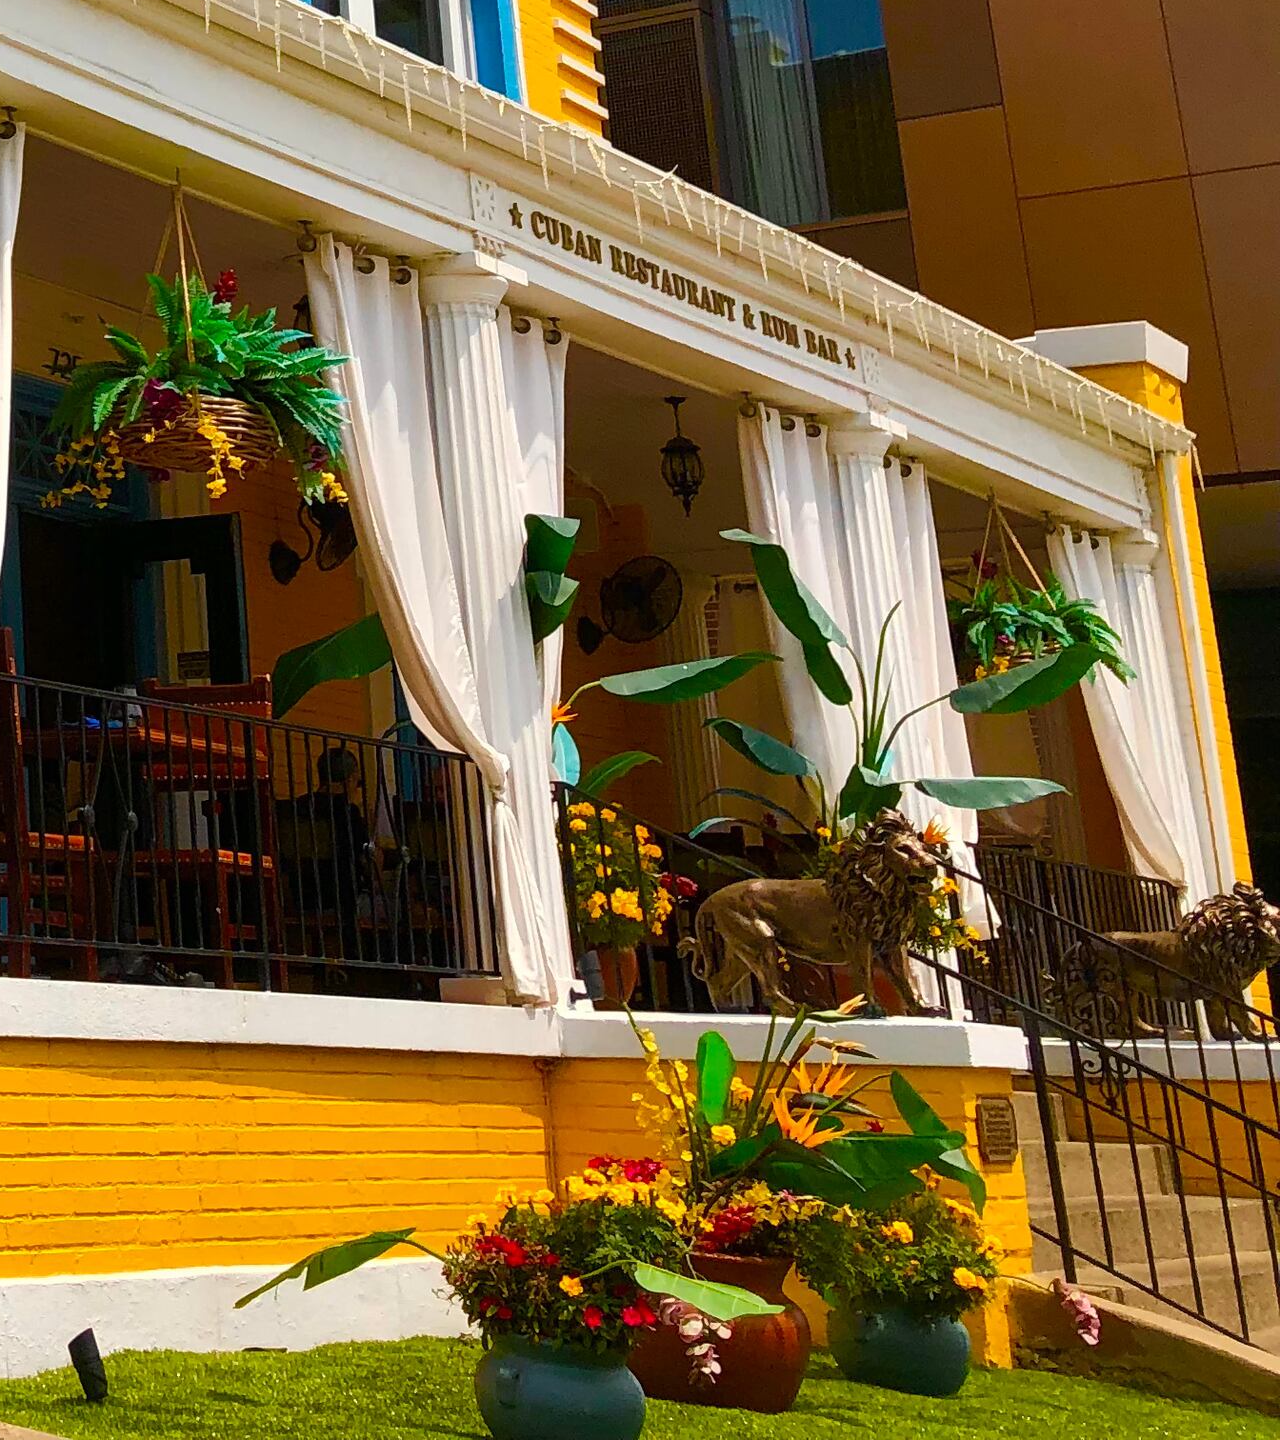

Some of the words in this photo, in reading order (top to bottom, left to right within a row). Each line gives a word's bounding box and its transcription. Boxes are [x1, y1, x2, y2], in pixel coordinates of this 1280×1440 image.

[530, 211, 603, 264] CUBAN
[608, 244, 737, 322] RESTAURANT
[742, 303, 757, 330] &
[759, 310, 800, 348] RUM
[804, 328, 843, 365] BAR
